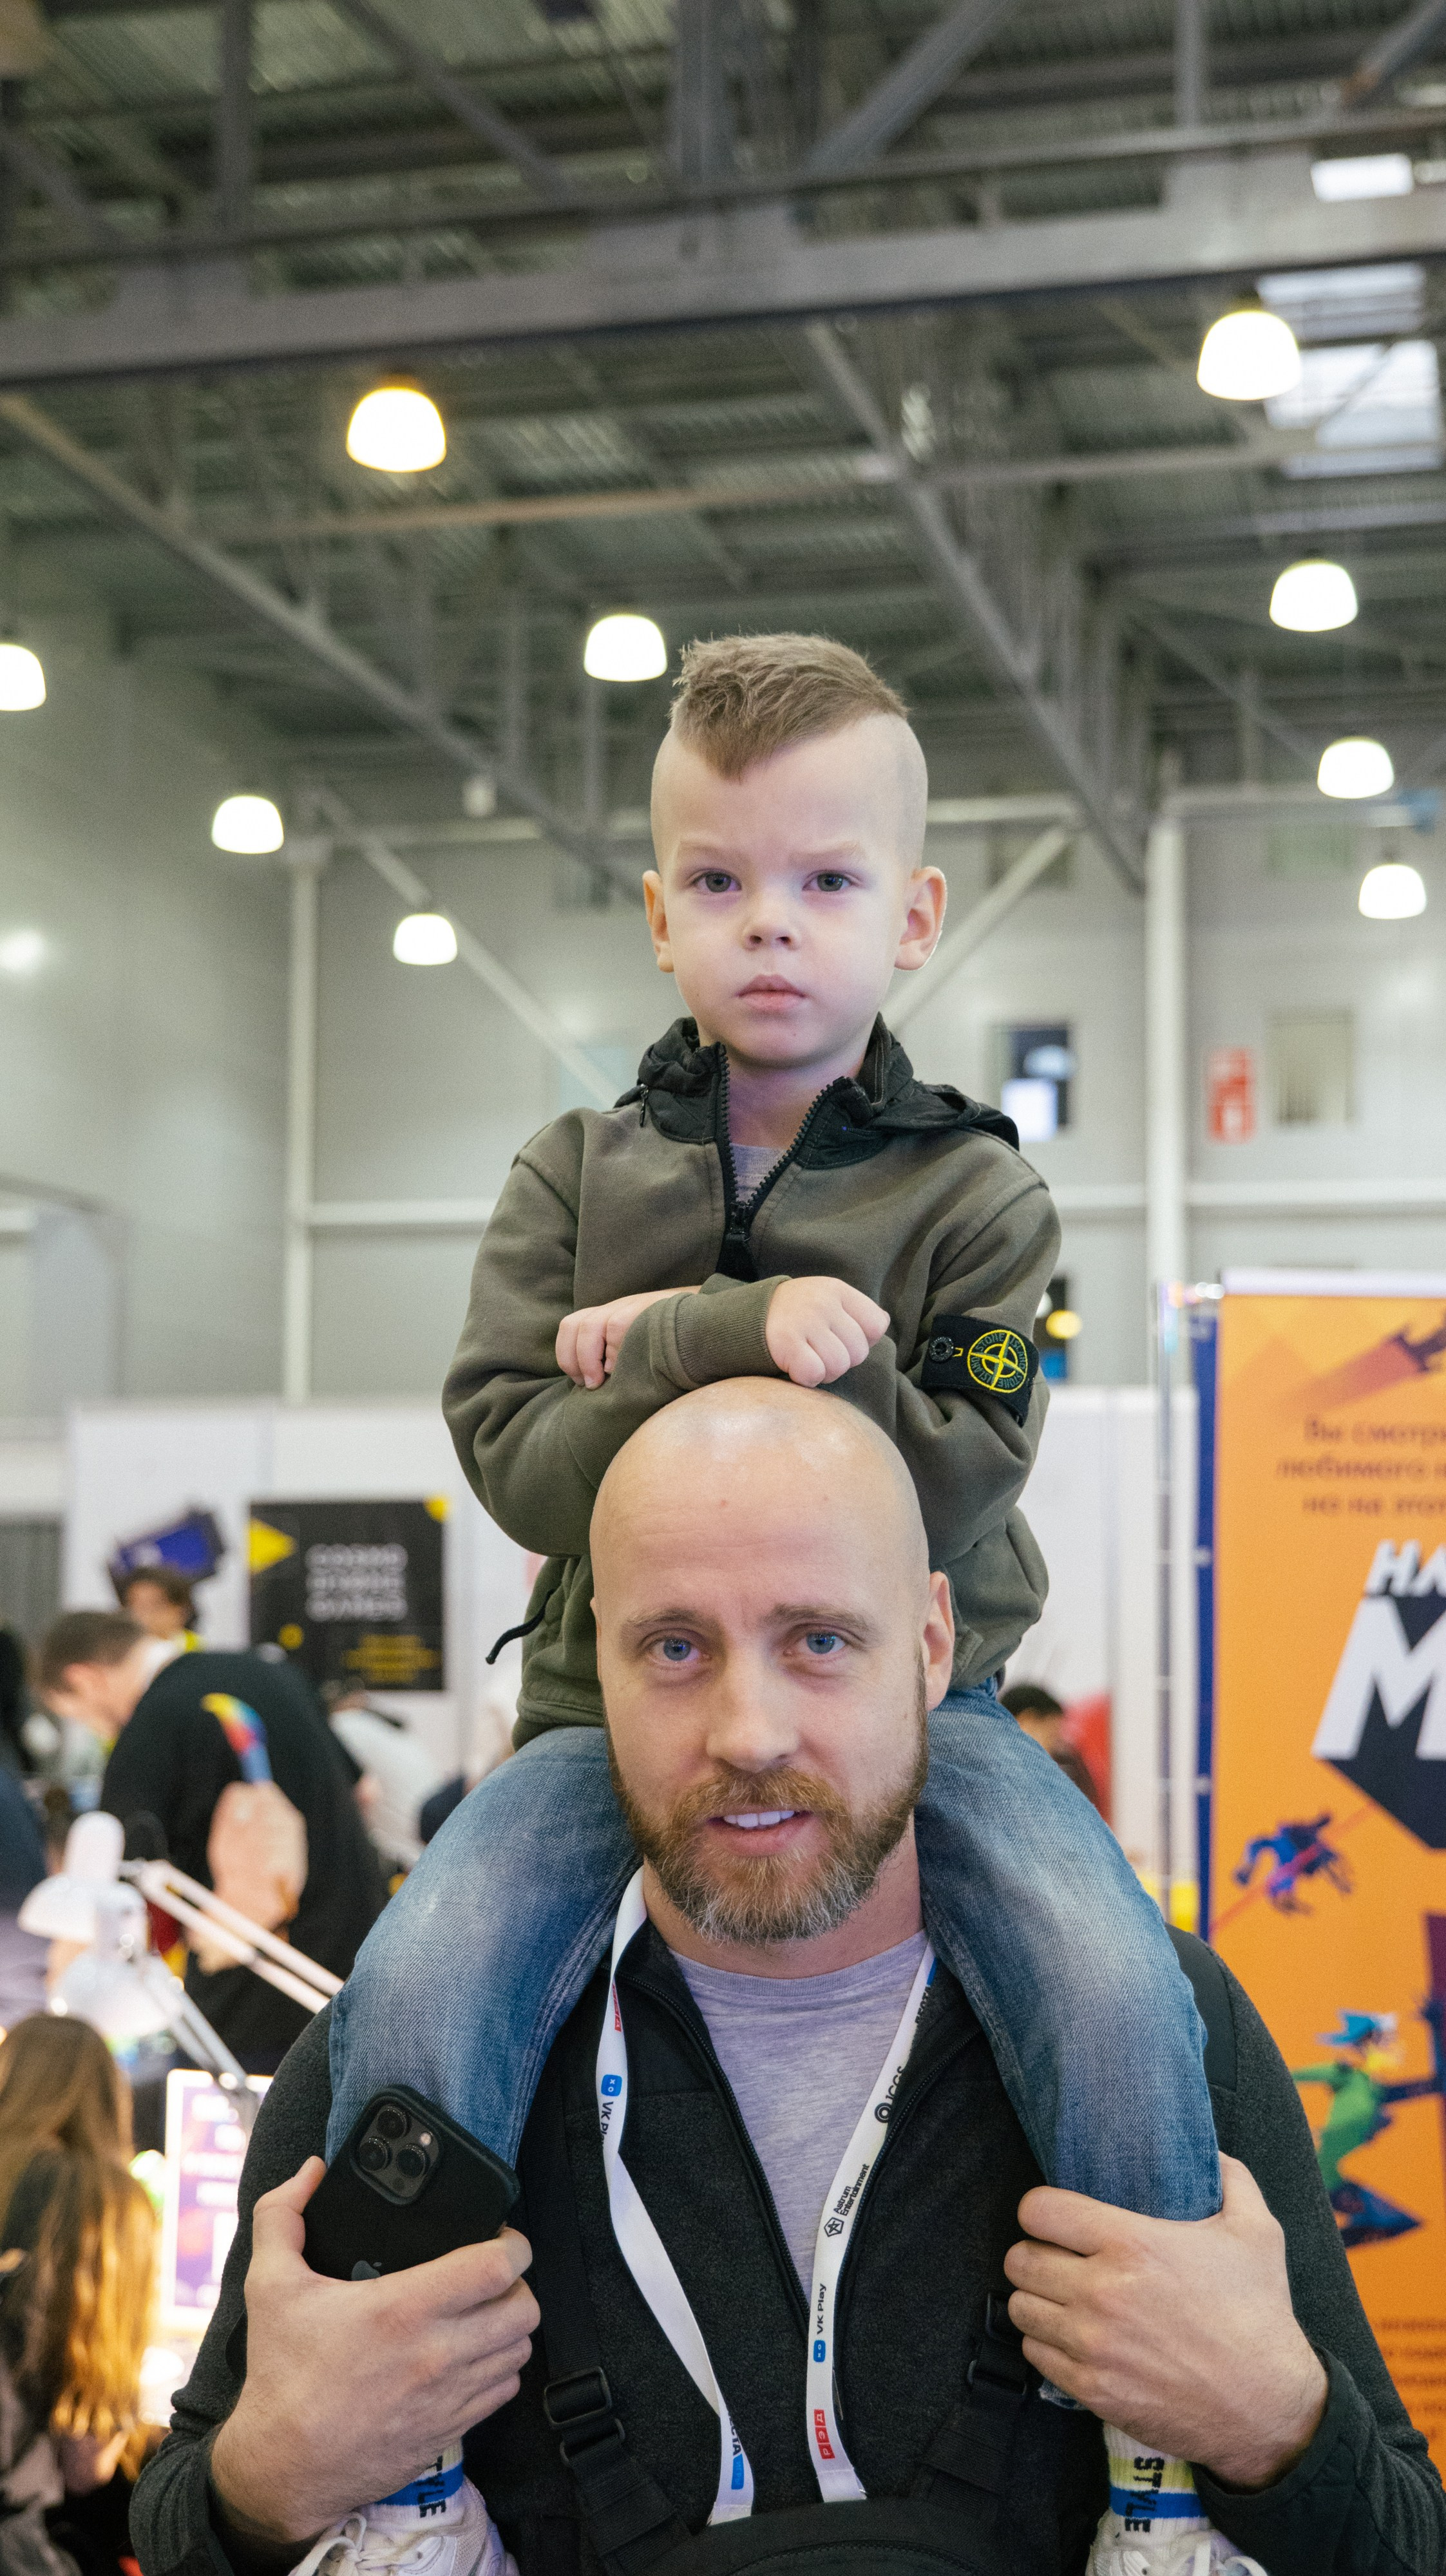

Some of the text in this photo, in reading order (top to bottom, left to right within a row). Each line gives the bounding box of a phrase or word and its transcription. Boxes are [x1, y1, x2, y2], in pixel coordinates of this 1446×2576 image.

[975, 1333, 1005, 1352] STONE
[1009, 1336, 1026, 1369] ISLAND
[971, 1356, 992, 1383] ISLAND
[998, 1372, 1023, 1388] STONE
[600, 2101, 614, 2145] VK Pl
[833, 2186, 851, 2214] Astrum
[839, 2164, 870, 2216] Entertainment
[817, 2283, 826, 2334] VK Play
[728, 2415, 741, 2456] СТА
[416, 2455, 446, 2518] TYLE
[1125, 2456, 1165, 2532] STYLE
